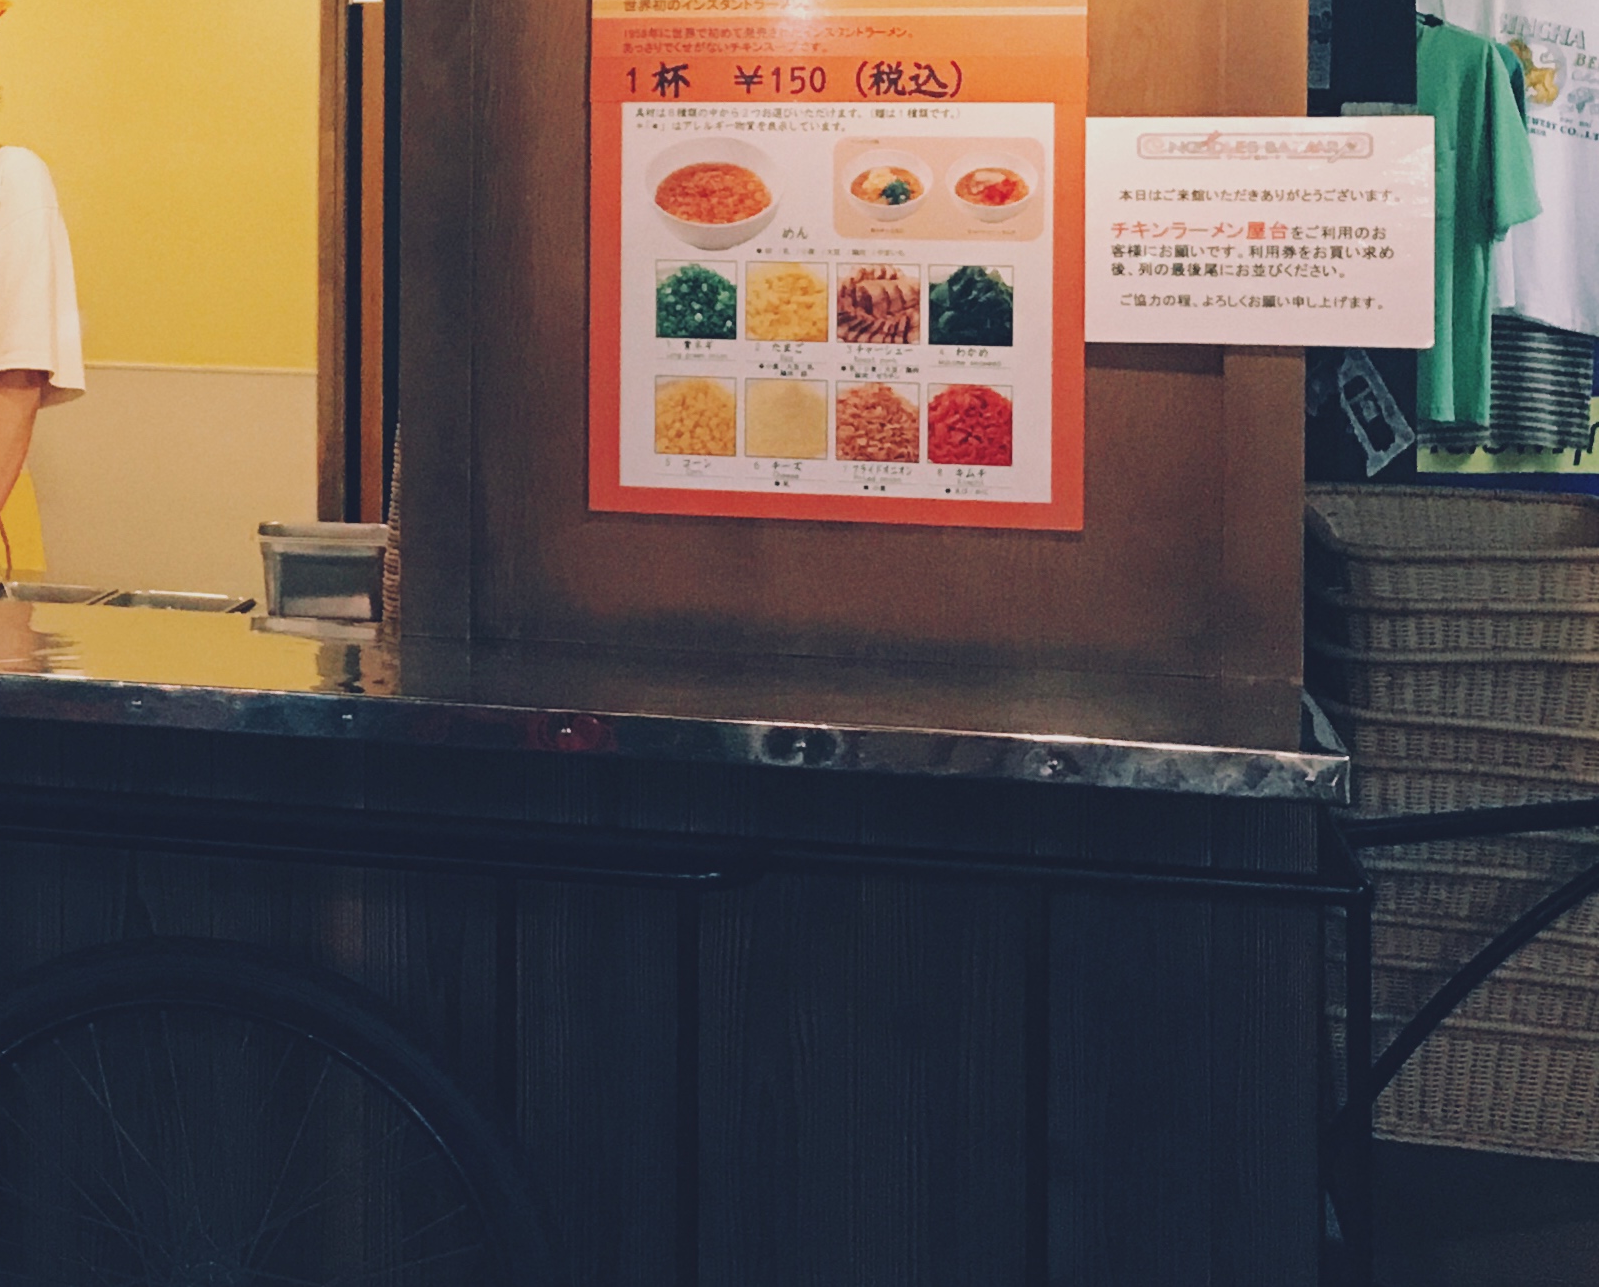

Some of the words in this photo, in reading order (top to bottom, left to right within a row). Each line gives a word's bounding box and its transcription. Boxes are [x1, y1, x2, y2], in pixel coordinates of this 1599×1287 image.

[734, 65, 828, 95] ¥150
[1119, 189, 1401, 202] 本日はご来館いただきありがとうございます。
[1110, 221, 1387, 240] チキンラーメン屋台をご利用のお
[1110, 244, 1395, 260] 客様にお願いです。利用券をお買い求め
[1110, 262, 1345, 278] 後、列の最後尾にお並びください。
[1119, 293, 1385, 309] ご協力の程、よろしくお願い申し上げます。
